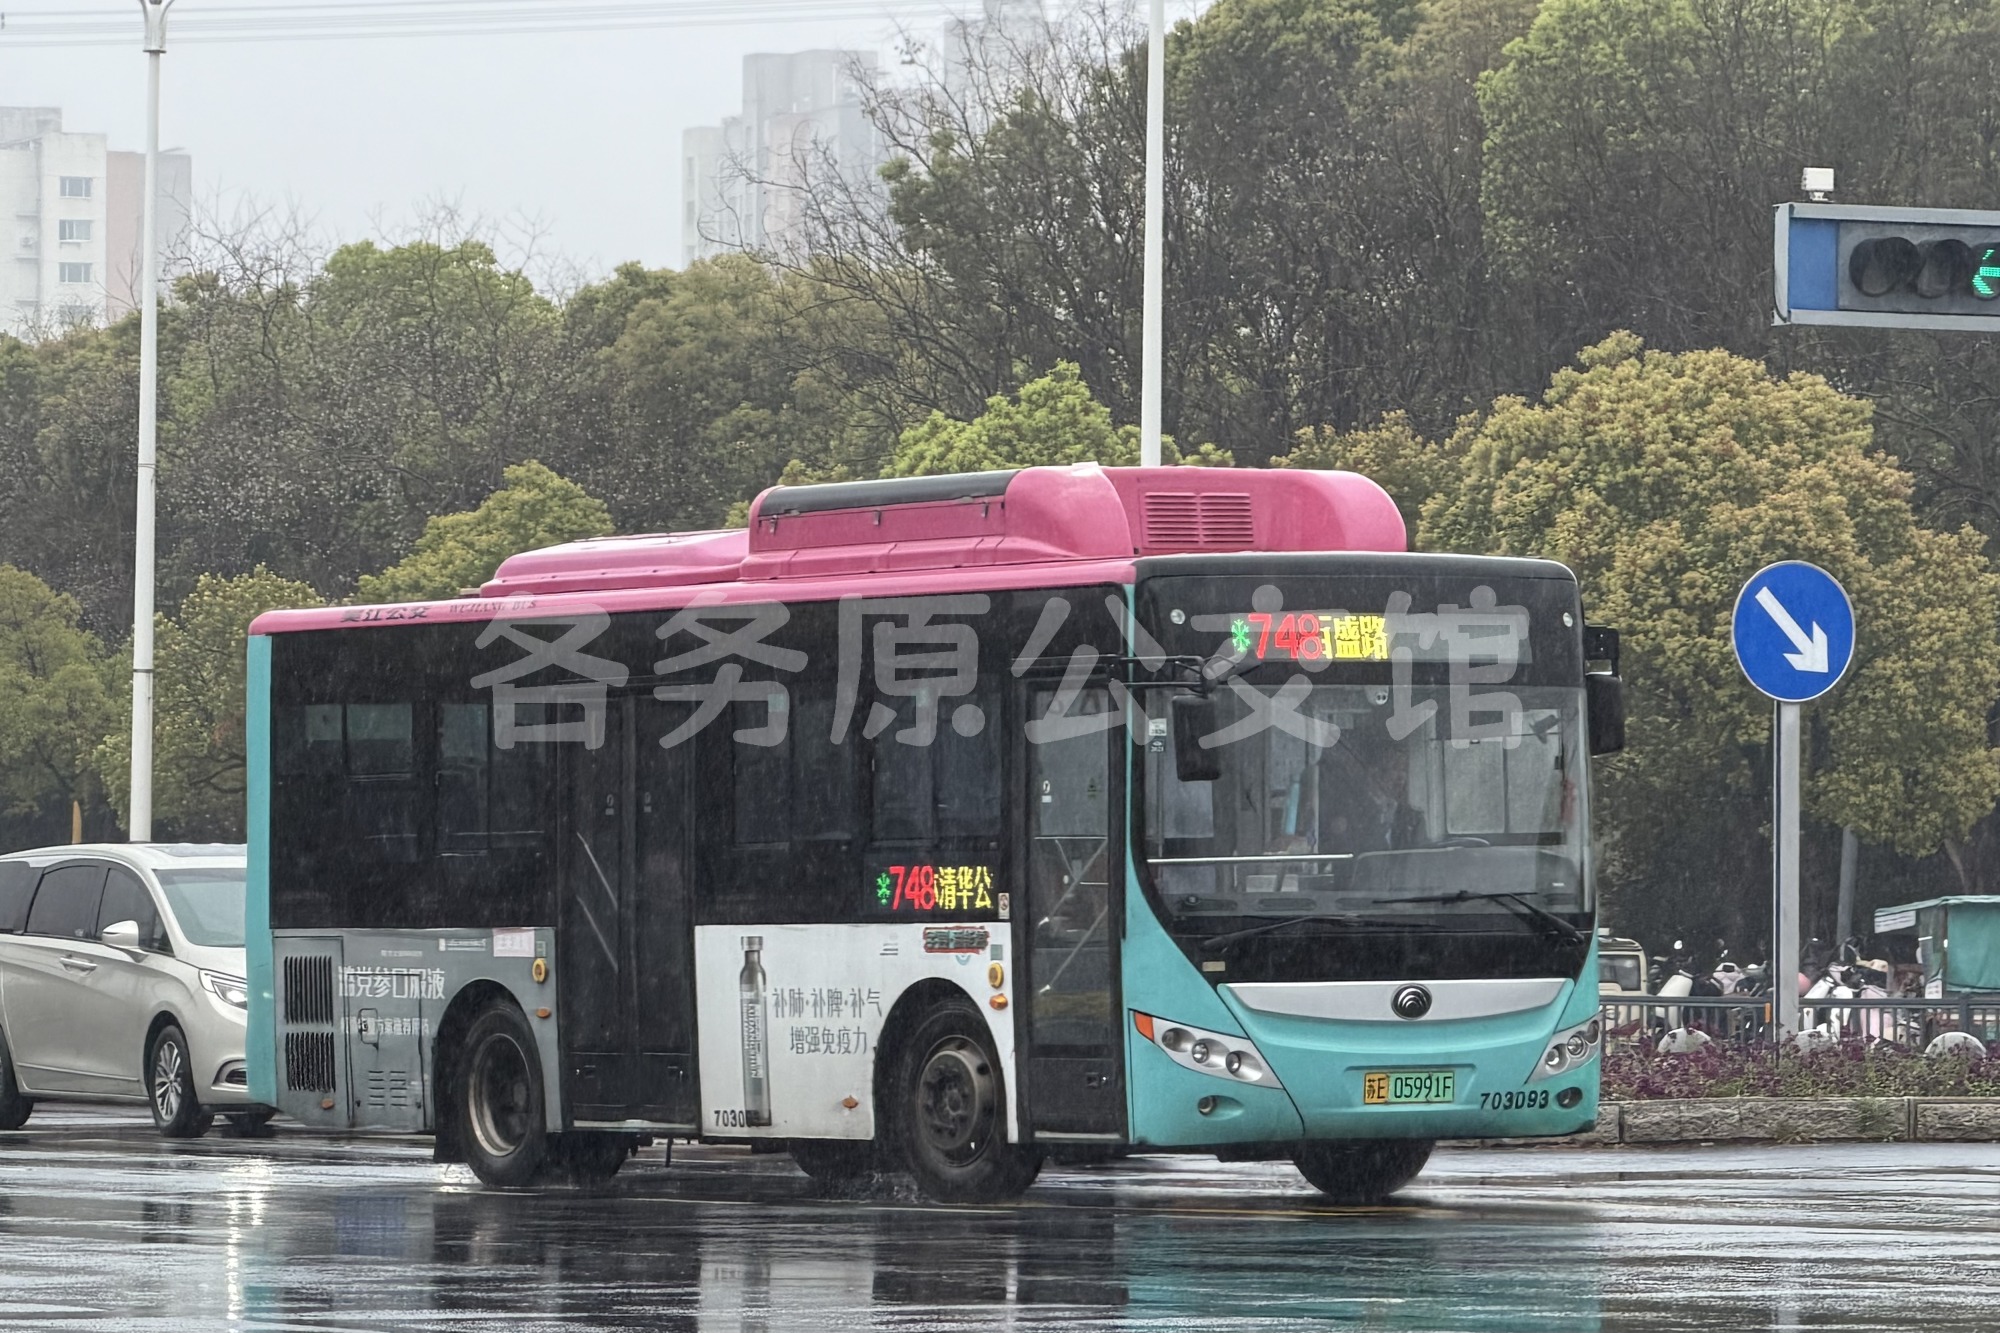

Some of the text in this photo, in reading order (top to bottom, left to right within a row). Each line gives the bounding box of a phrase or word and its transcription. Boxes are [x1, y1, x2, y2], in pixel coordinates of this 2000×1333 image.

[340, 605, 431, 623] 吴江公交
[1248, 613, 1322, 660] 748
[889, 865, 935, 910] 748
[790, 1025, 867, 1055] 增强免疫力
[1366, 1075, 1453, 1099] 苏E 05991F
[1480, 1089, 1549, 1111] 703093
